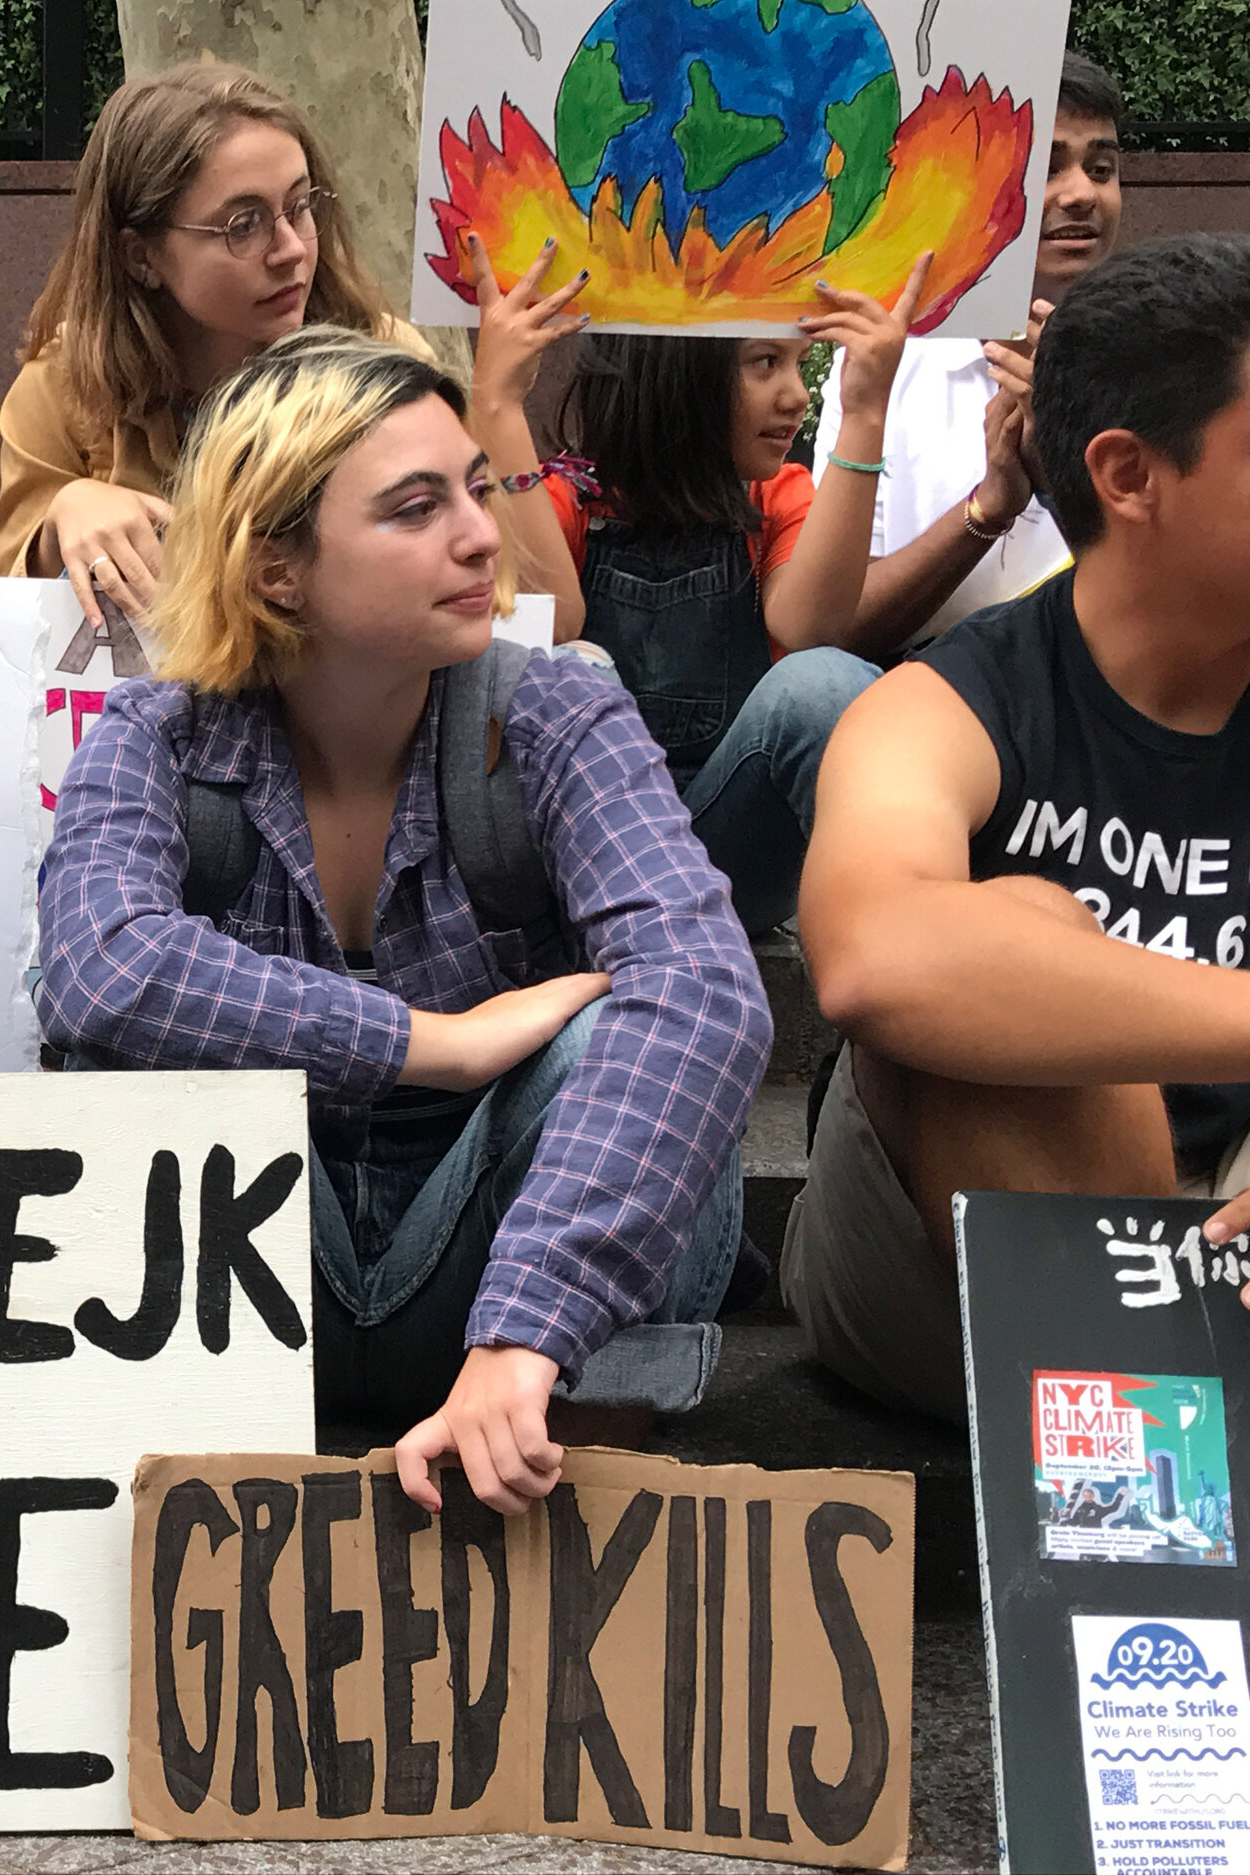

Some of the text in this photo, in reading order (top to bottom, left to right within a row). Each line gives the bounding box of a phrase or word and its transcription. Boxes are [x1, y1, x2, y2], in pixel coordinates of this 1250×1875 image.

[1005, 798, 1231, 896] IM ONE
[1042, 1382, 1104, 1408] NYC
[1043, 1407, 1135, 1434] CLIMATE
[1044, 1433, 1136, 1460] STRIKE
[152, 1466, 510, 1819] GREED
[542, 1482, 894, 1847] KILLS
[1116, 1635, 1194, 1667] 09.20
[1086, 1699, 1239, 1719] Climate Strike
[1094, 1723, 1237, 1742] We Are Rising Too
[1106, 1821, 1126, 1831] NO
[1129, 1820, 1167, 1831] MORE
[1170, 1820, 1217, 1830] FOSSIL
[1110, 1838, 1143, 1850] JUST
[1145, 1838, 1226, 1849] TRANSITION
[1112, 1856, 1149, 1867] HOLD
[1152, 1855, 1229, 1867] POLLUTERS
